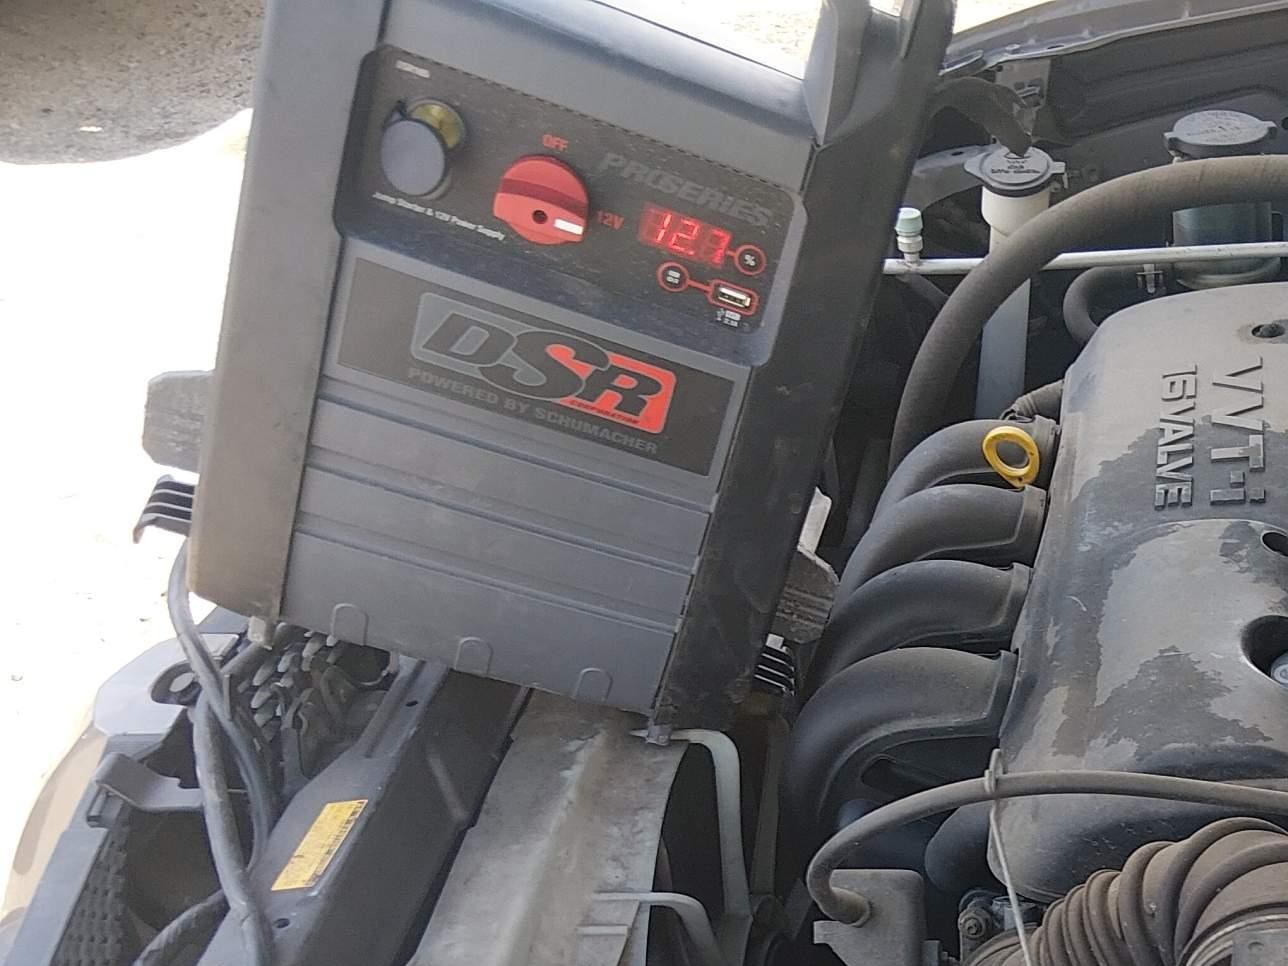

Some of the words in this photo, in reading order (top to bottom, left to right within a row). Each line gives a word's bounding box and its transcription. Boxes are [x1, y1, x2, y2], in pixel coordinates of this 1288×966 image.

[597, 209, 625, 230] 12V
[421, 311, 665, 418] DSR
[408, 366, 499, 405] POWERED
[503, 398, 531, 414] BY
[535, 407, 659, 454] SCHUMACHER
